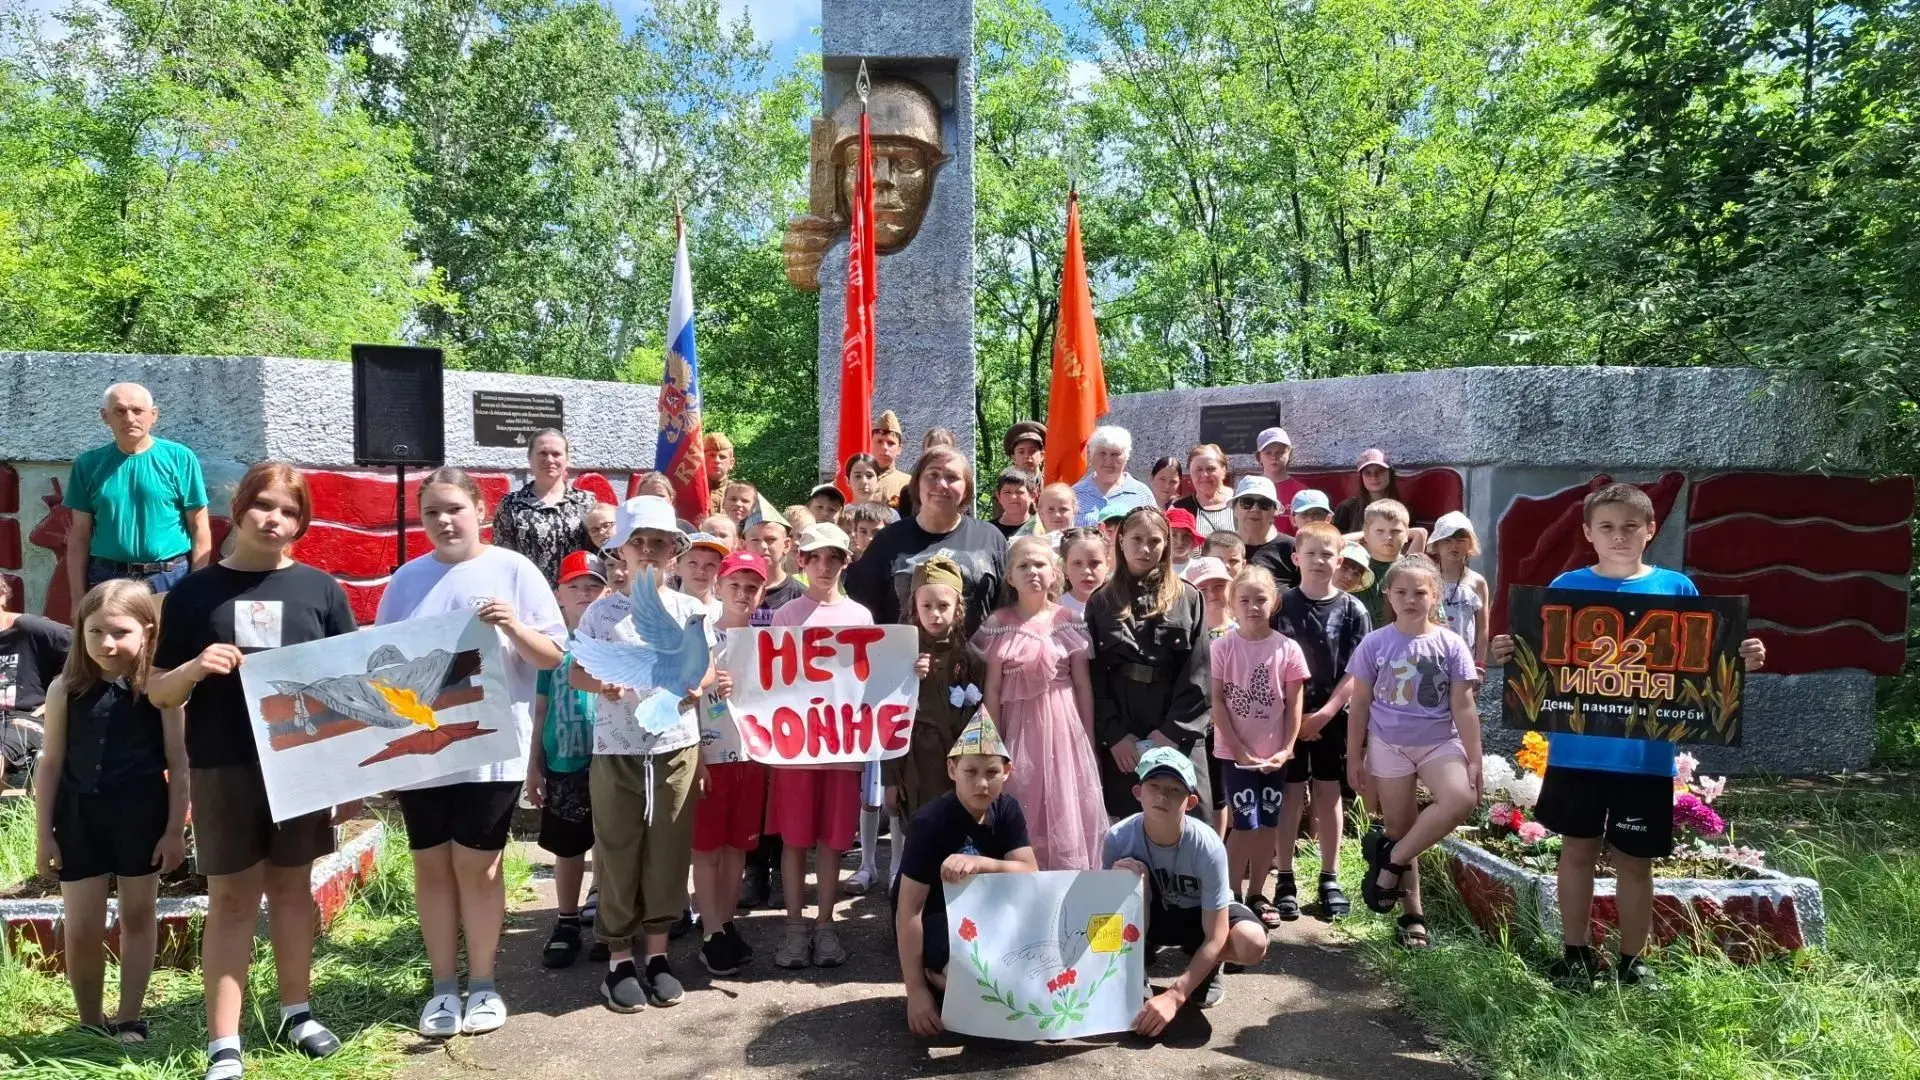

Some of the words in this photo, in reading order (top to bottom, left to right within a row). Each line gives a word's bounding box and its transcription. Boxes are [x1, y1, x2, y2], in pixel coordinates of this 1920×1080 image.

[1540, 605, 1713, 673] 1941
[1589, 635, 1648, 673] 22
[757, 626, 886, 692] НЕТ
[1560, 666, 1676, 700] ИЮНЯ
[737, 697, 911, 760] ВОЙНЕ
[1540, 699, 1575, 713] День
[1582, 701, 1632, 715] памяти
[1638, 707, 1647, 716] и
[1655, 708, 1705, 721] скорби
[1616, 822, 1631, 830] JUST
